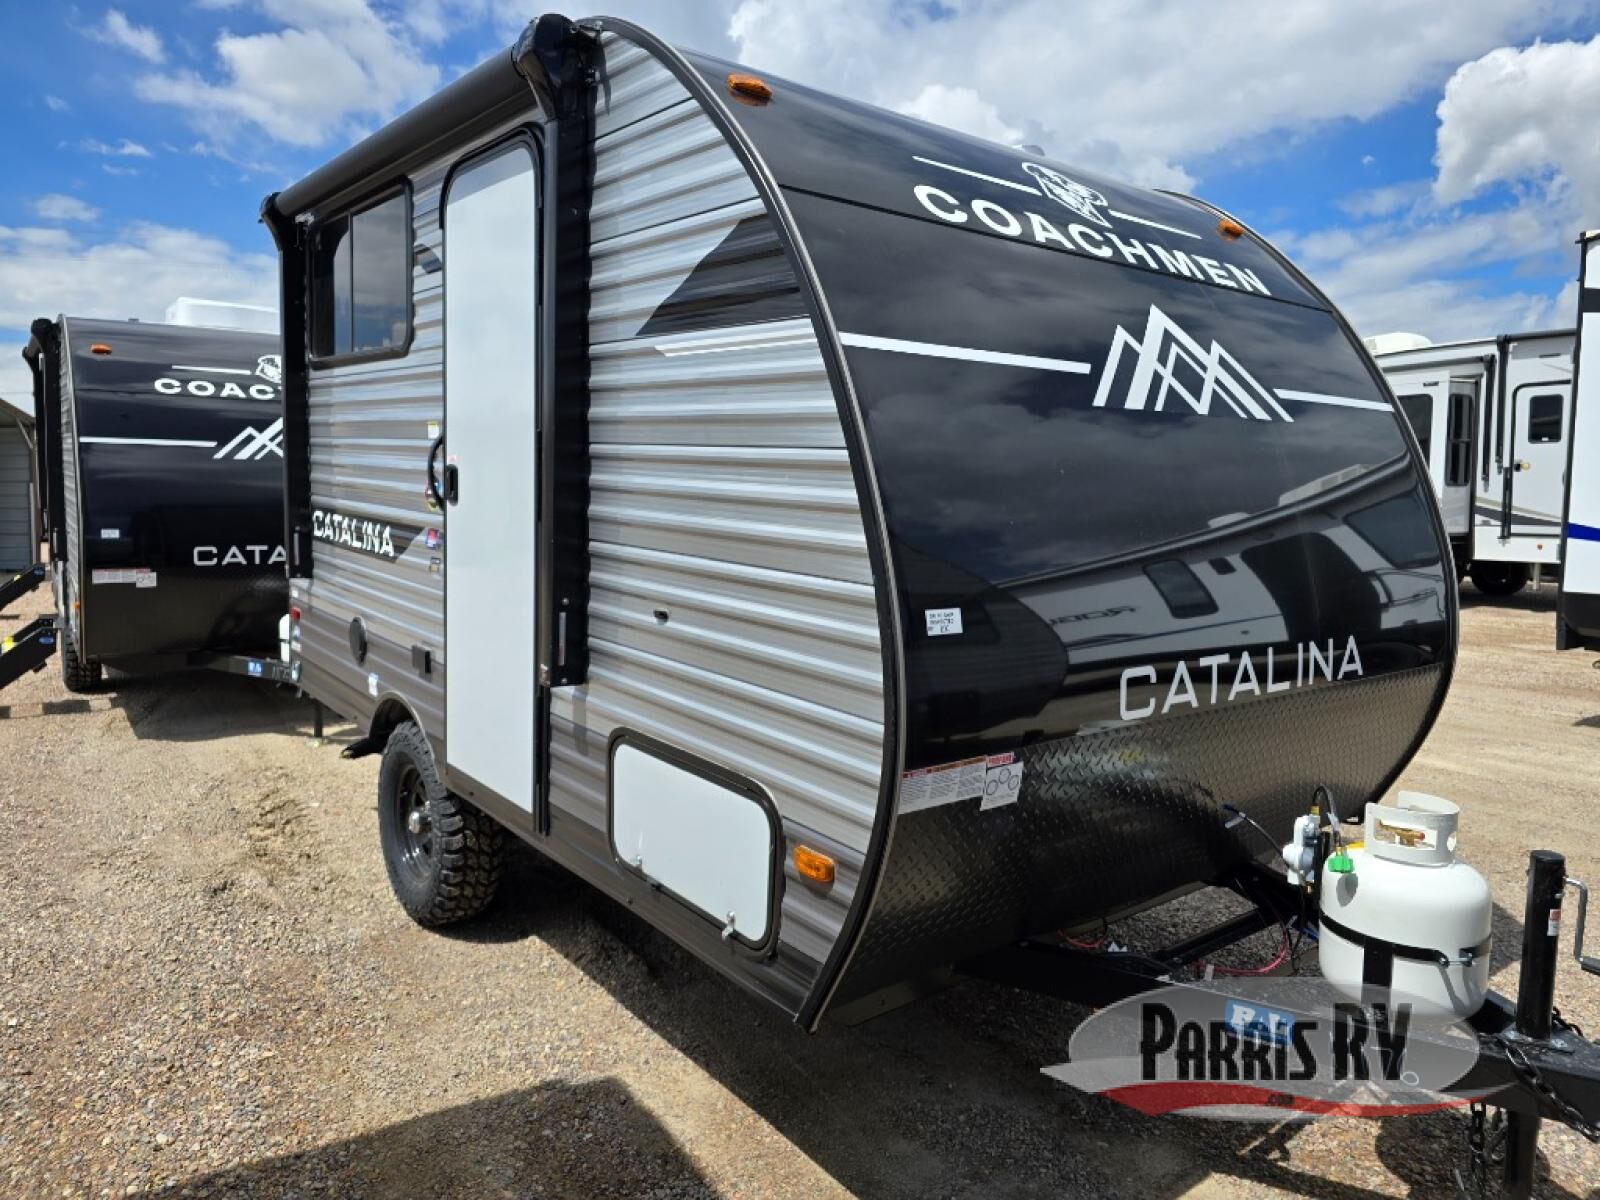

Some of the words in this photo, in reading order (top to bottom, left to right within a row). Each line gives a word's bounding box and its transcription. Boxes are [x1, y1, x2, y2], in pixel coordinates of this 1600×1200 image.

[913, 185, 1271, 296] COACHMEN
[154, 378, 281, 401] COAC
[312, 511, 395, 557] CATALINA
[1119, 635, 1364, 720] CATALINA
